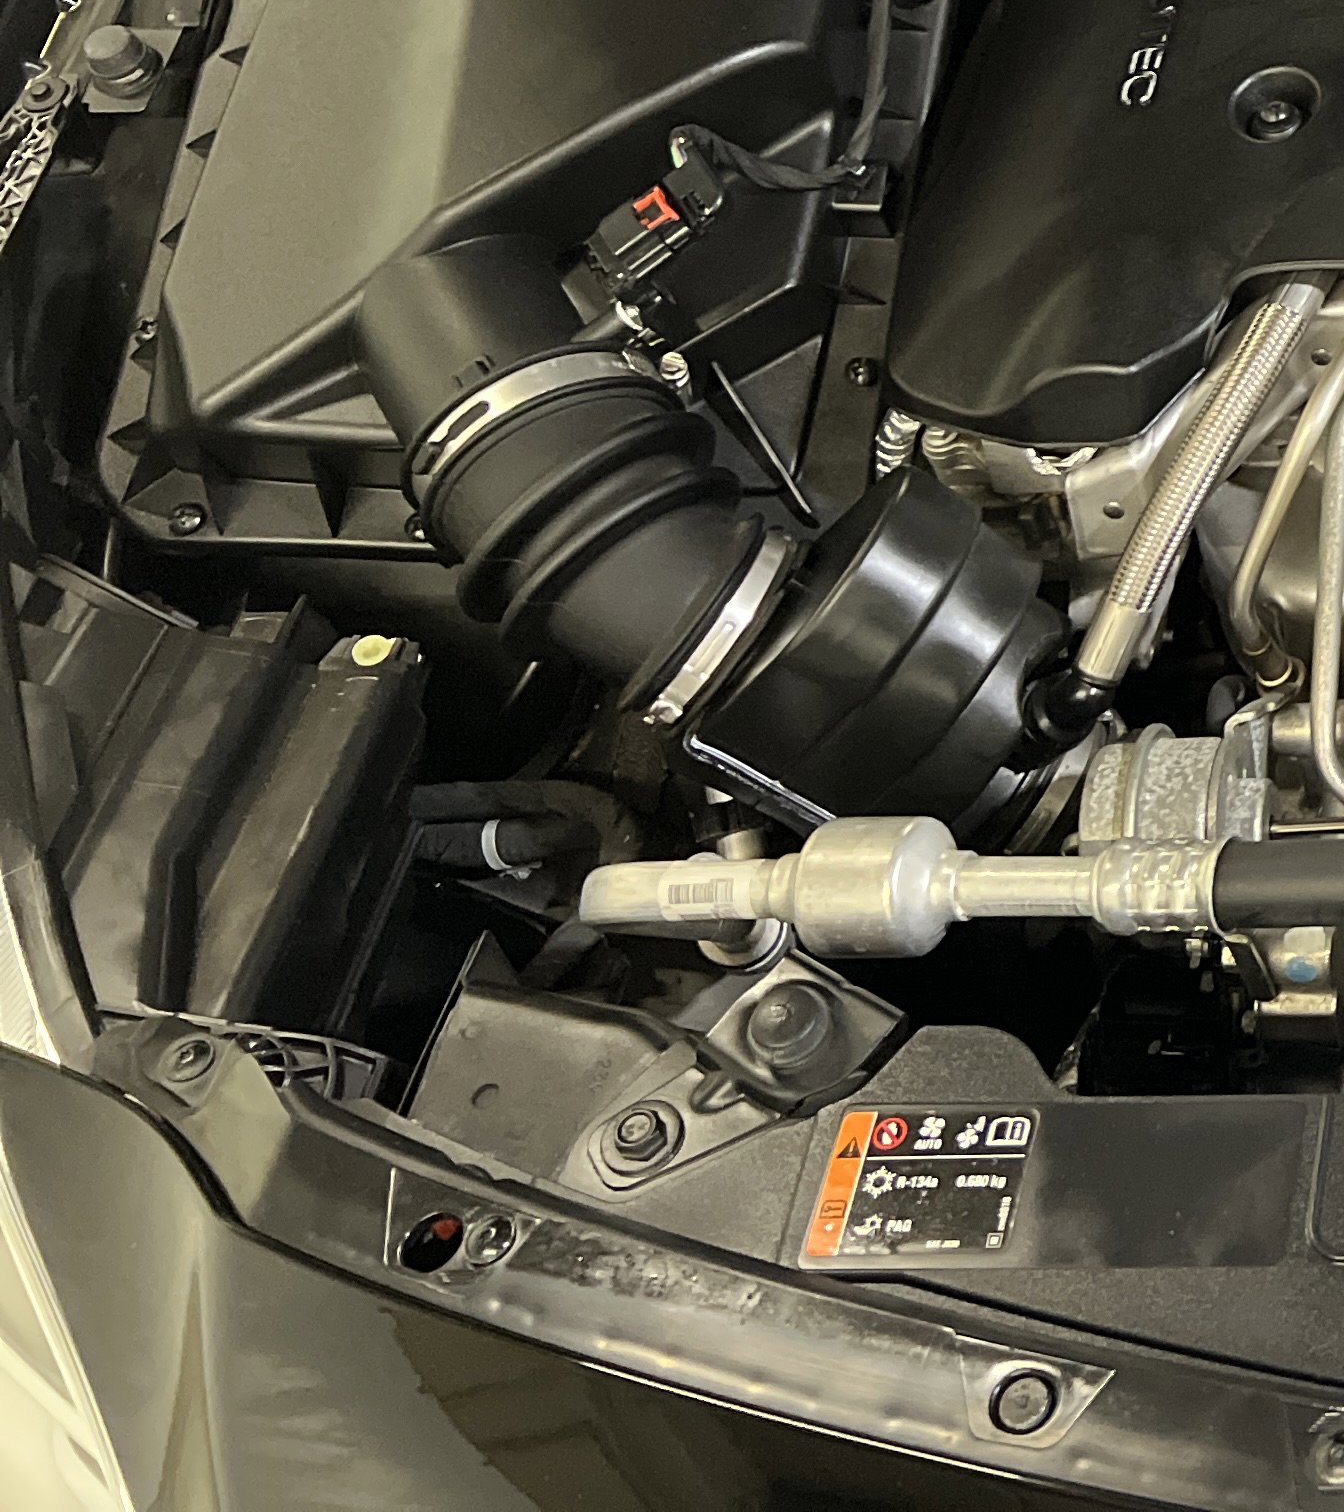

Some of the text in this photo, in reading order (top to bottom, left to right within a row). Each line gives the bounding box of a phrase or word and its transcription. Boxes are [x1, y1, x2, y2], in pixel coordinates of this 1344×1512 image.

[913, 1138, 943, 1150] AUTO
[896, 1175, 939, 1189] R-134a
[989, 1174, 1007, 1190] kg
[885, 1218, 913, 1233] PAG
